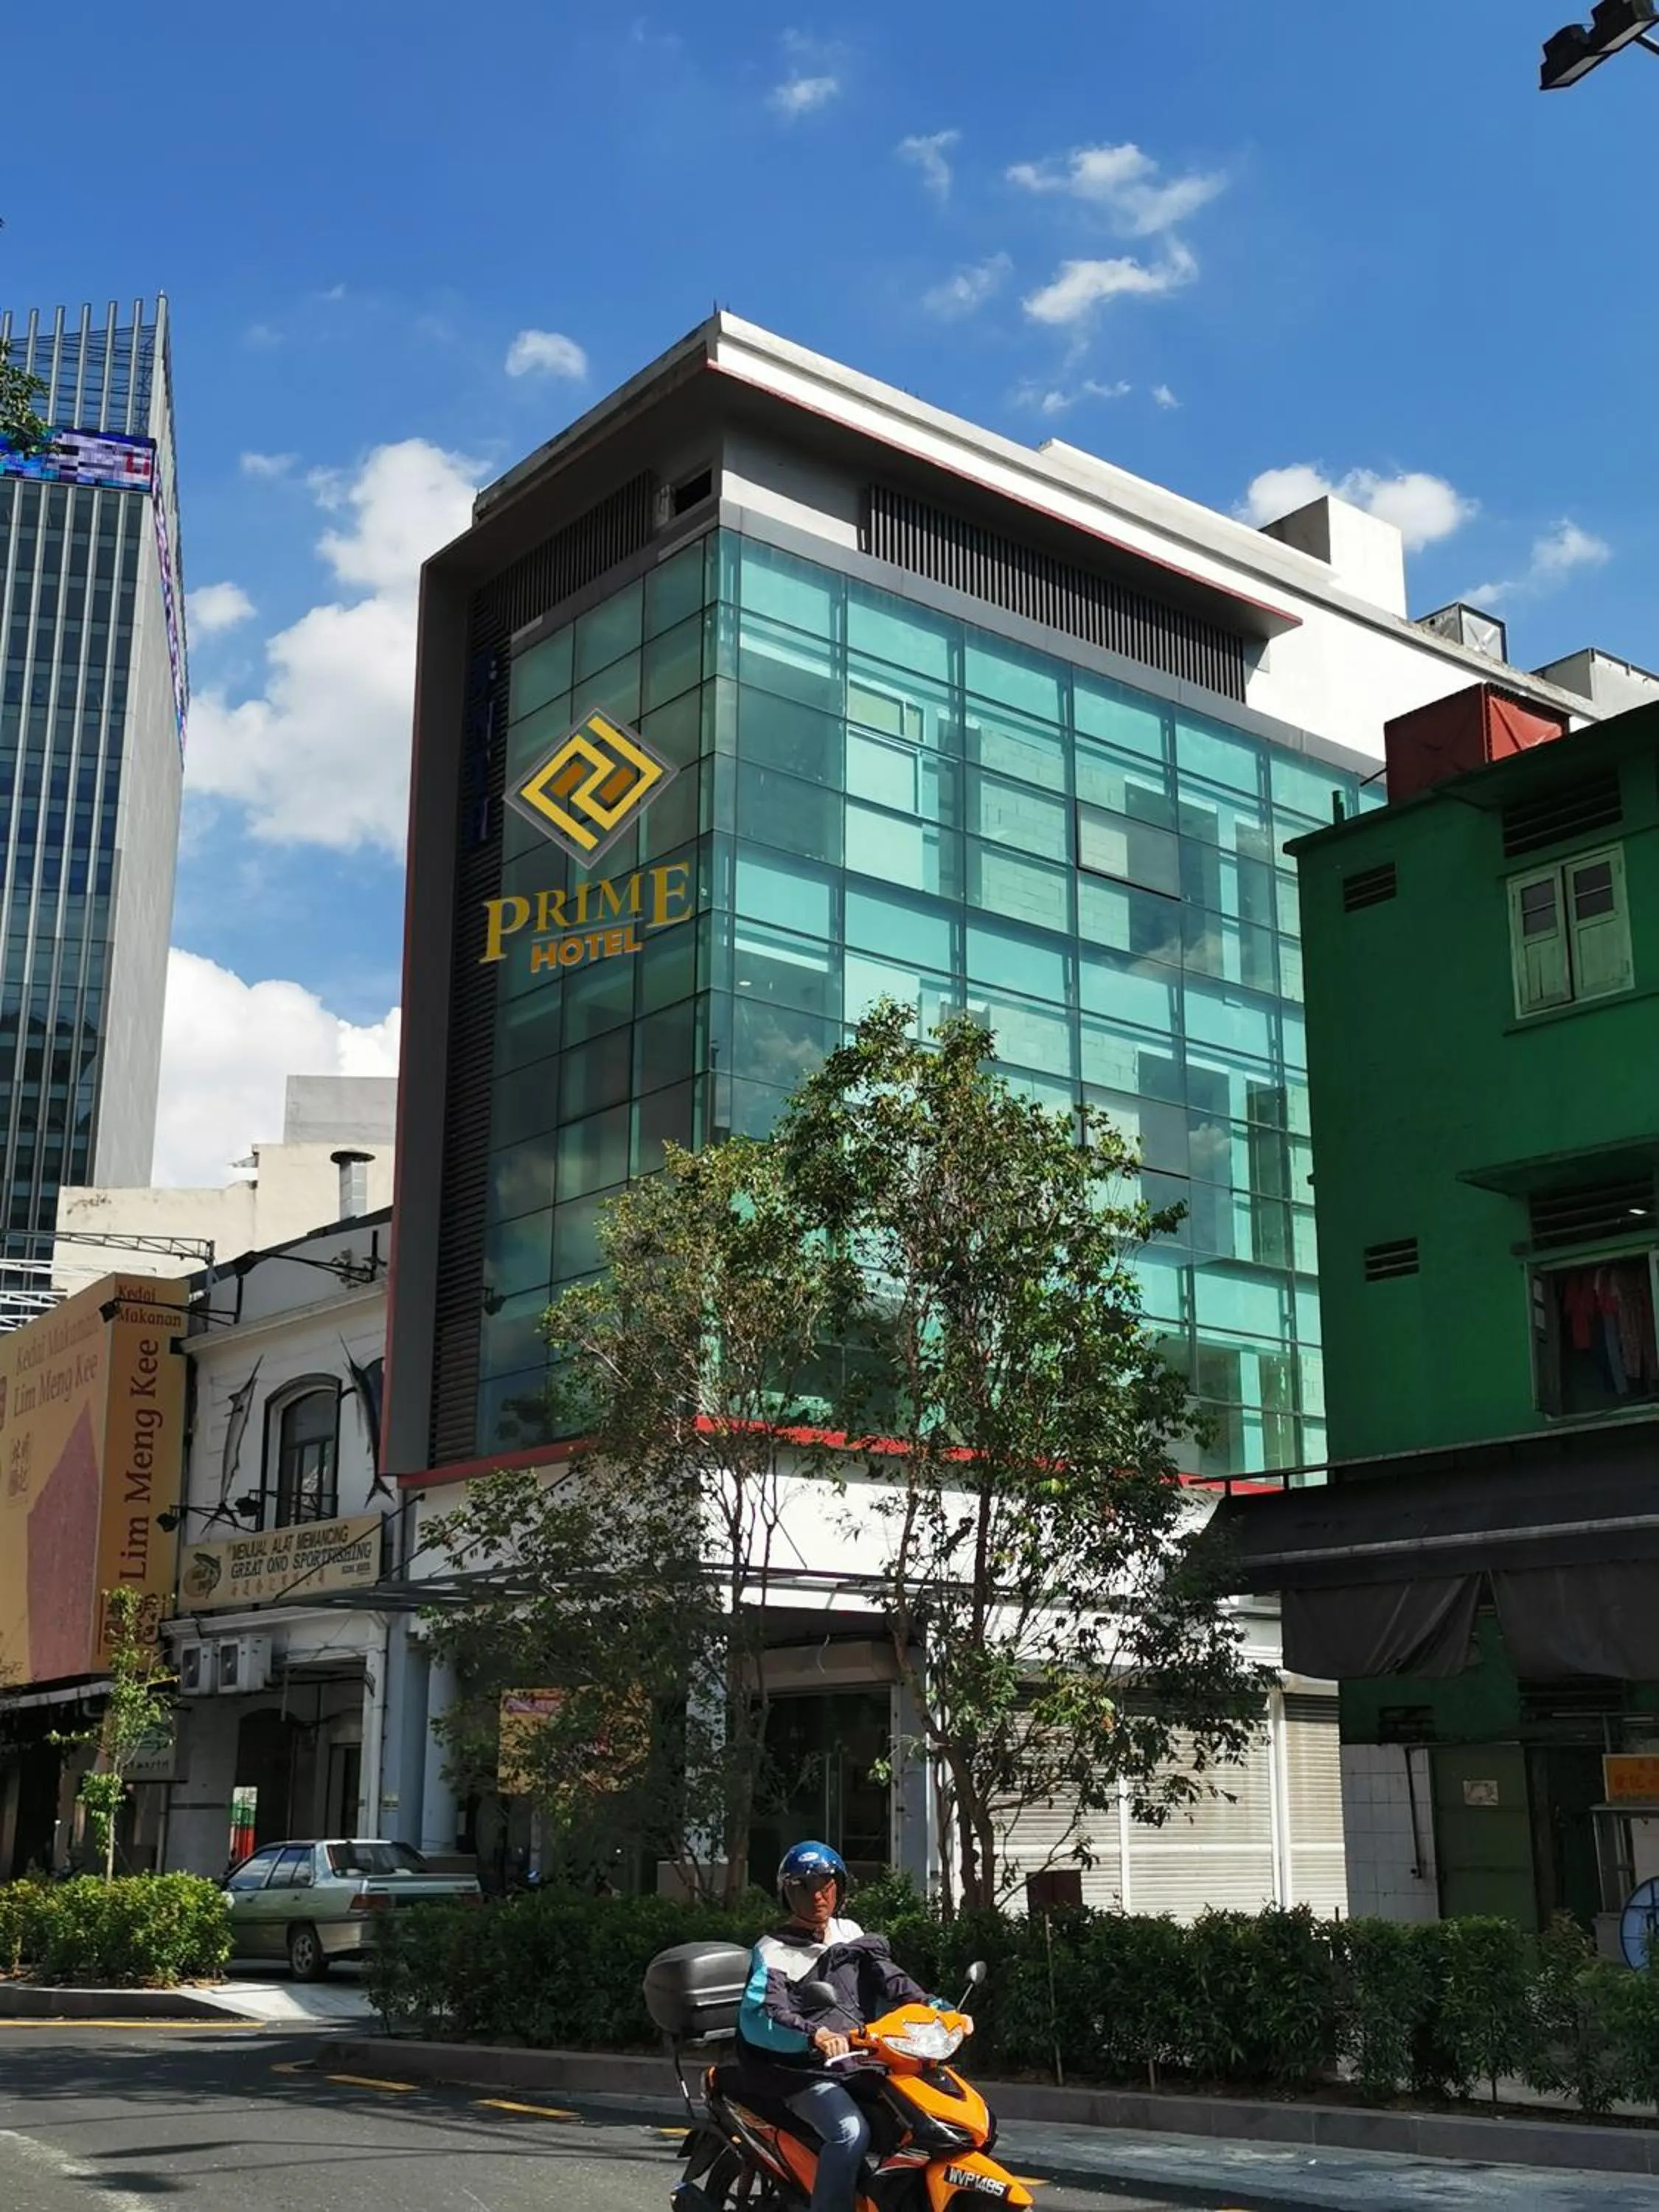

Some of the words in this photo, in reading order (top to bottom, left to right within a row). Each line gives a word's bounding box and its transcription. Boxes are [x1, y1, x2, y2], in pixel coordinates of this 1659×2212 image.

[478, 862, 692, 963] PRIME
[530, 926, 643, 973] HOTEL
[14, 1383, 36, 1417] Lim
[39, 1366, 73, 1405] Meng
[74, 1354, 98, 1389] Kee
[130, 1339, 159, 1399] Kee
[125, 1408, 163, 1503] Meng
[119, 1517, 150, 1581] Lim
[231, 1559, 264, 1579] GREAT
[267, 1555, 288, 1573] ONO
